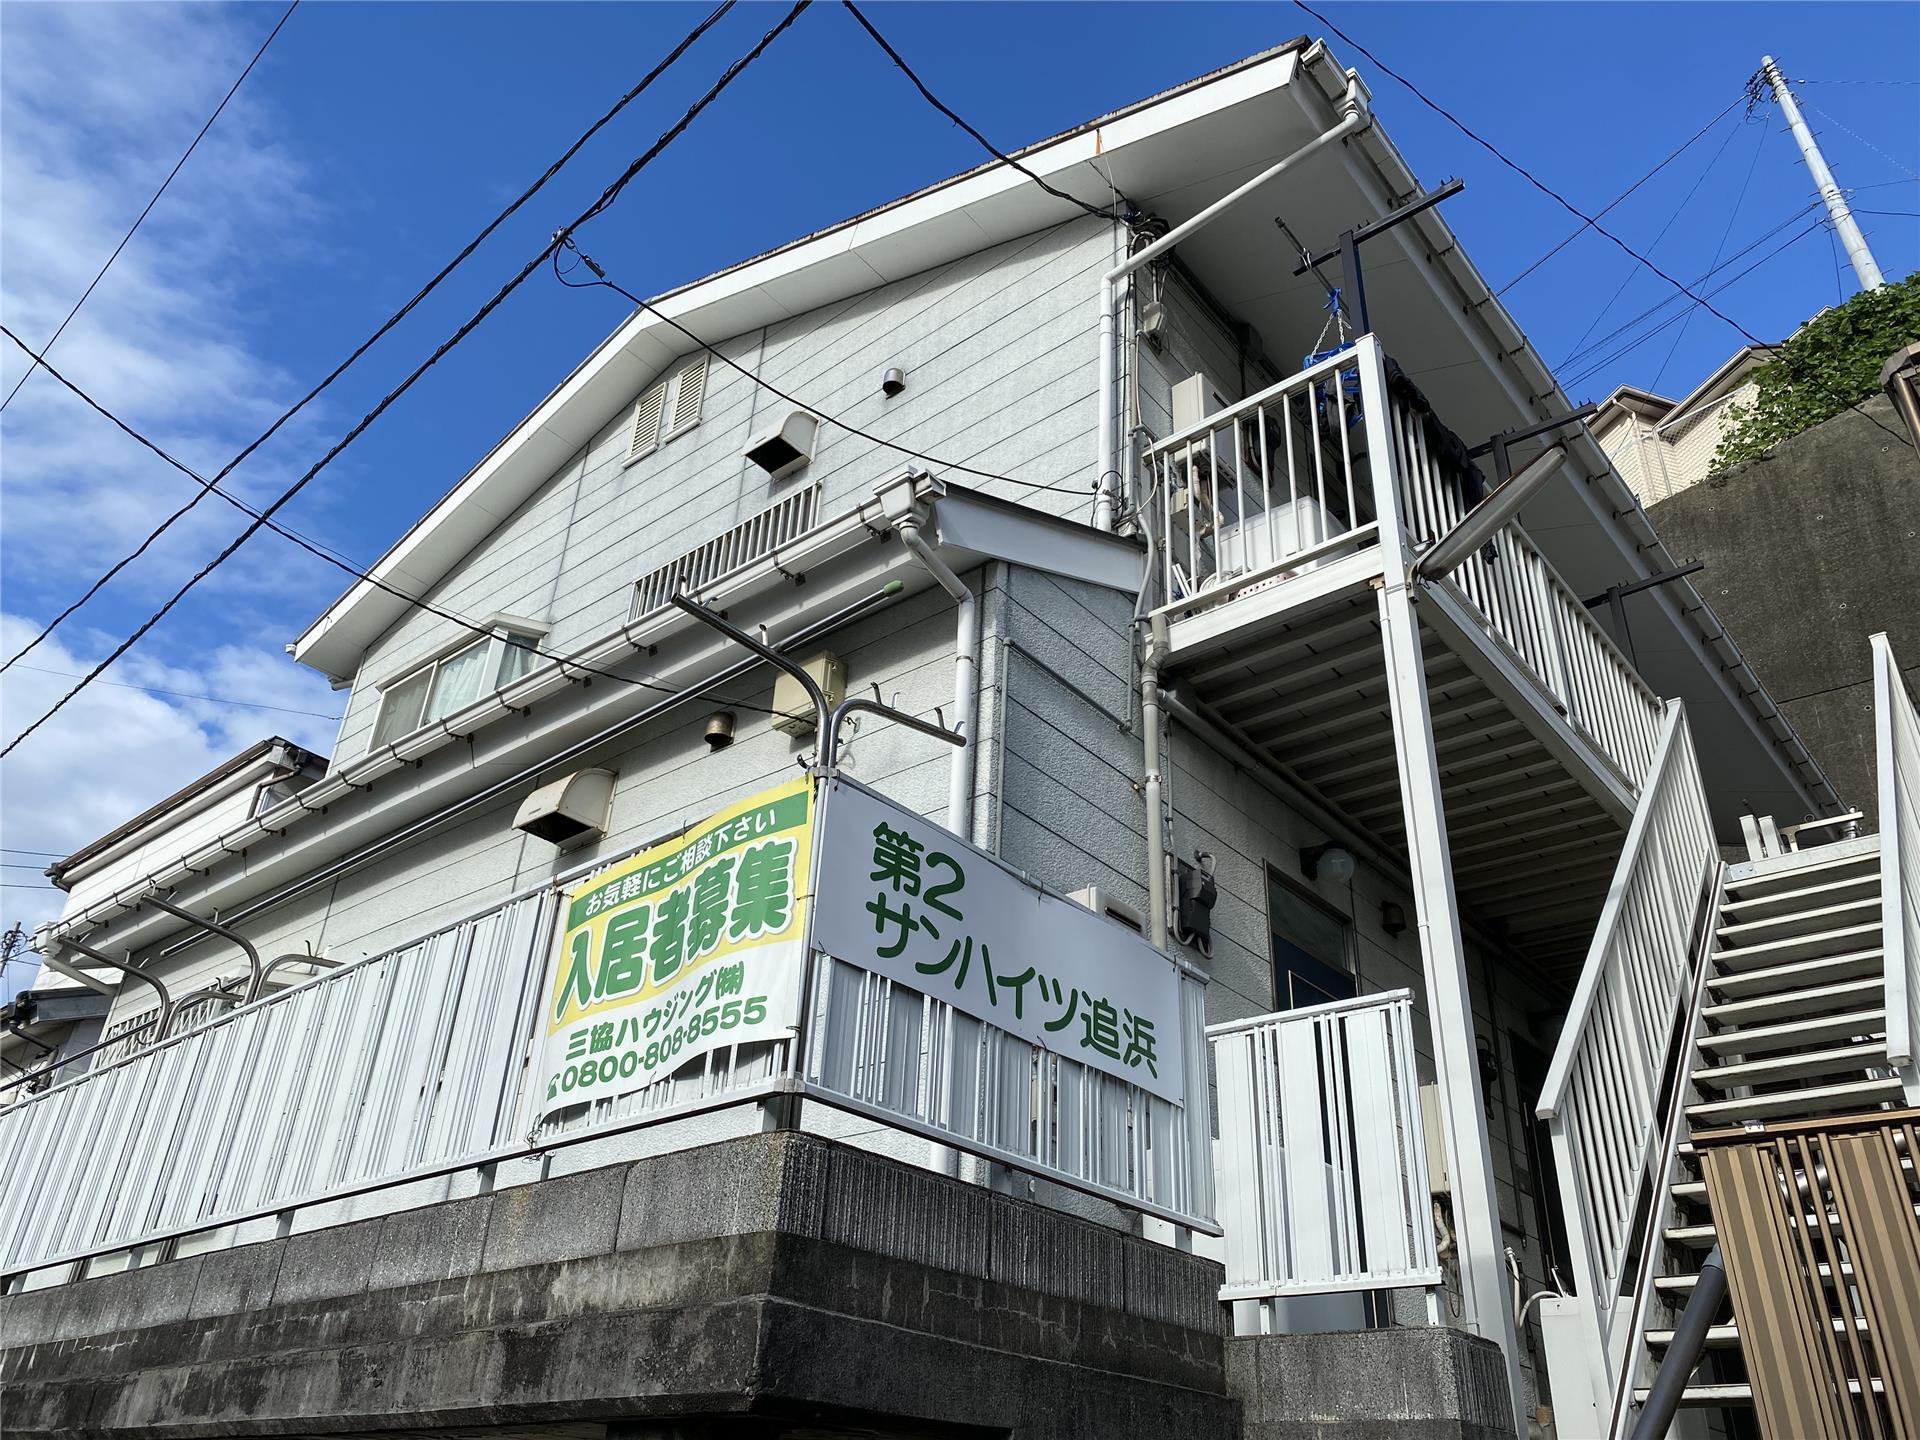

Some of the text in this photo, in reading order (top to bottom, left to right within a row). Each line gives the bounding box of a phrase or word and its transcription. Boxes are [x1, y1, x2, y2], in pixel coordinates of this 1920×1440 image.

[586, 809, 776, 916] お気軽にご相談下さい
[871, 822, 965, 920] 第2
[557, 840, 793, 1018] 入居者募集
[866, 892, 1157, 1079] サンハイツ追浜
[561, 996, 768, 1092] 0800-808-8555
